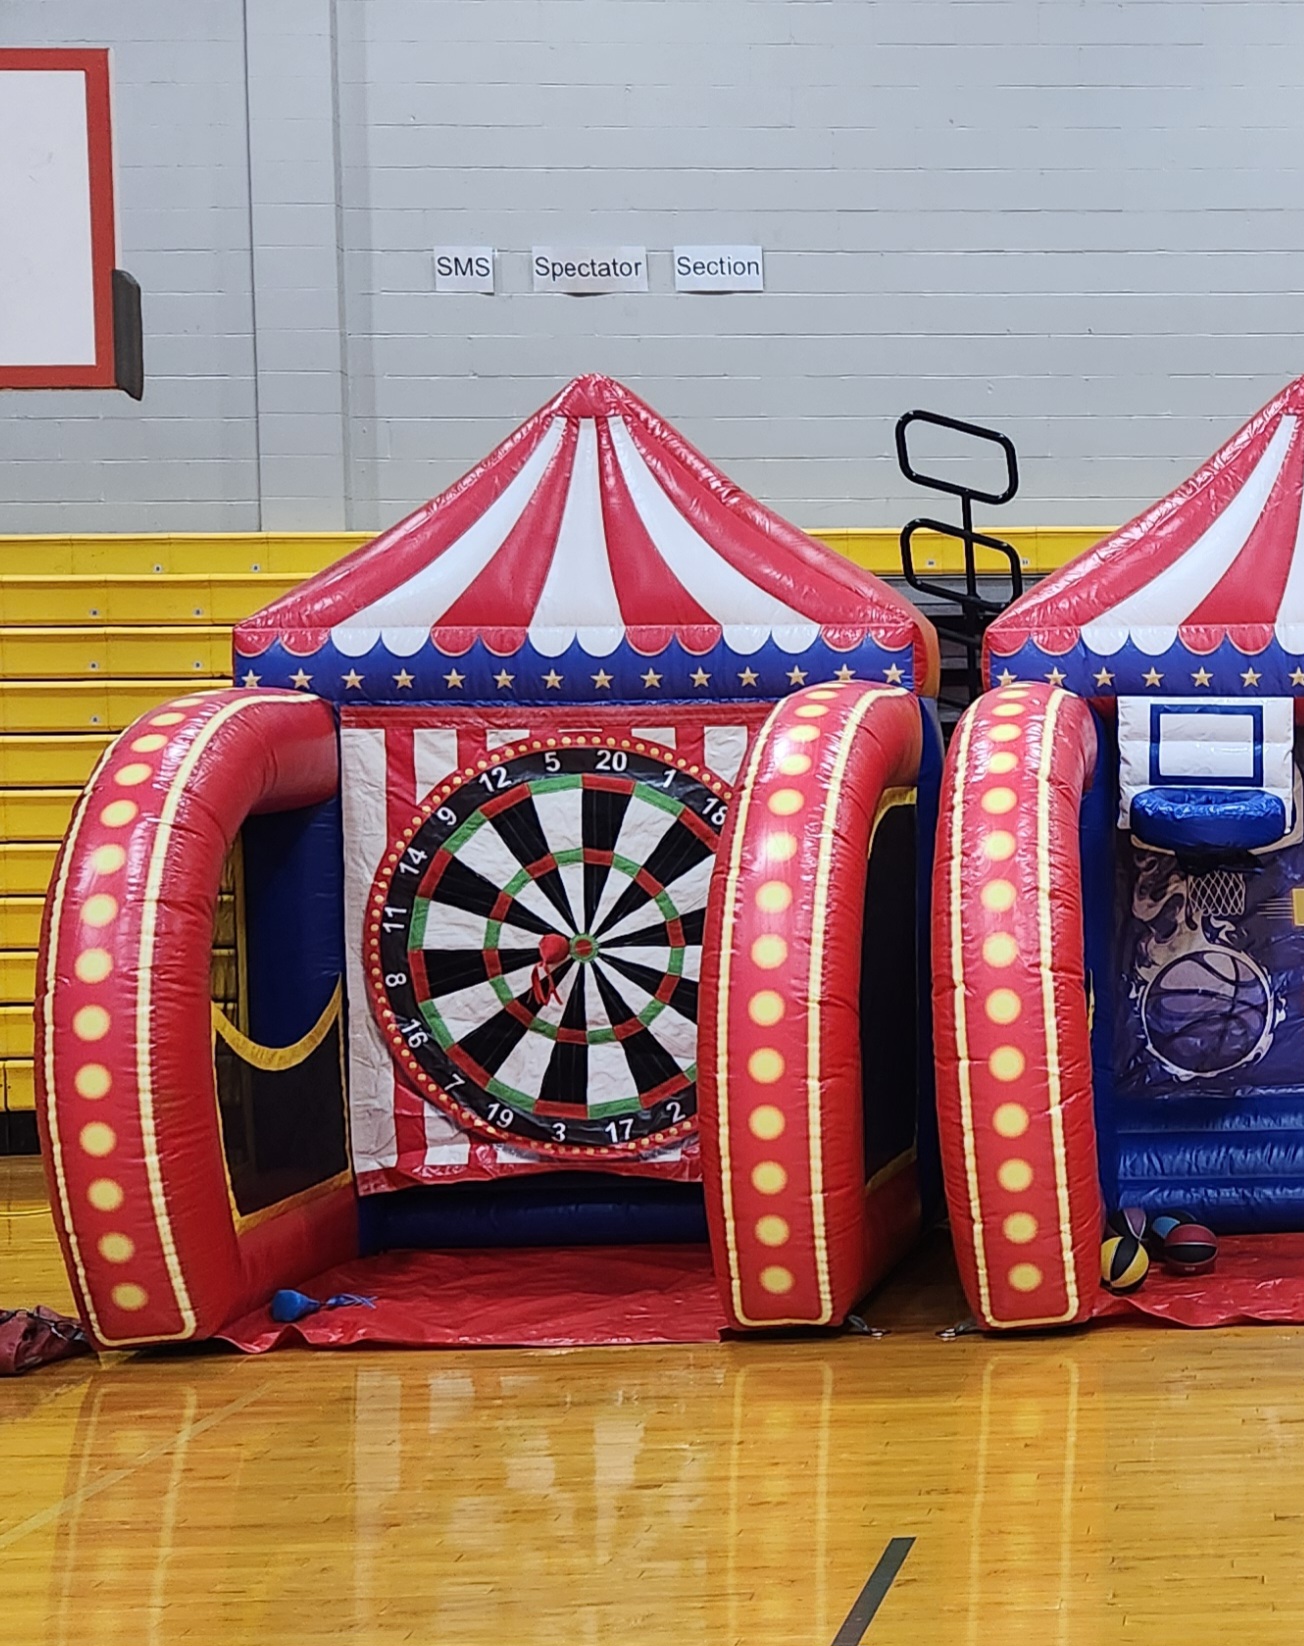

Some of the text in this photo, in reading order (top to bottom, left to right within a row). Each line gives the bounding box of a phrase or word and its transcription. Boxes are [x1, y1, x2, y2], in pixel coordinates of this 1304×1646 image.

[436, 255, 760, 282] SMS Spectator Section
[545, 751, 561, 772] 5
[595, 750, 628, 772] 20
[478, 766, 512, 793] 12
[662, 768, 677, 788] 1
[436, 806, 457, 826] 9
[702, 797, 728, 826] 18
[399, 847, 428, 875] 14
[382, 905, 407, 934] 11
[385, 972, 407, 988] 8
[401, 1018, 429, 1049] 16
[444, 1073, 466, 1092] 7
[486, 1103, 514, 1129] 19
[665, 1101, 686, 1124] 2
[551, 1122, 567, 1142] 3
[604, 1118, 634, 1144] 17
